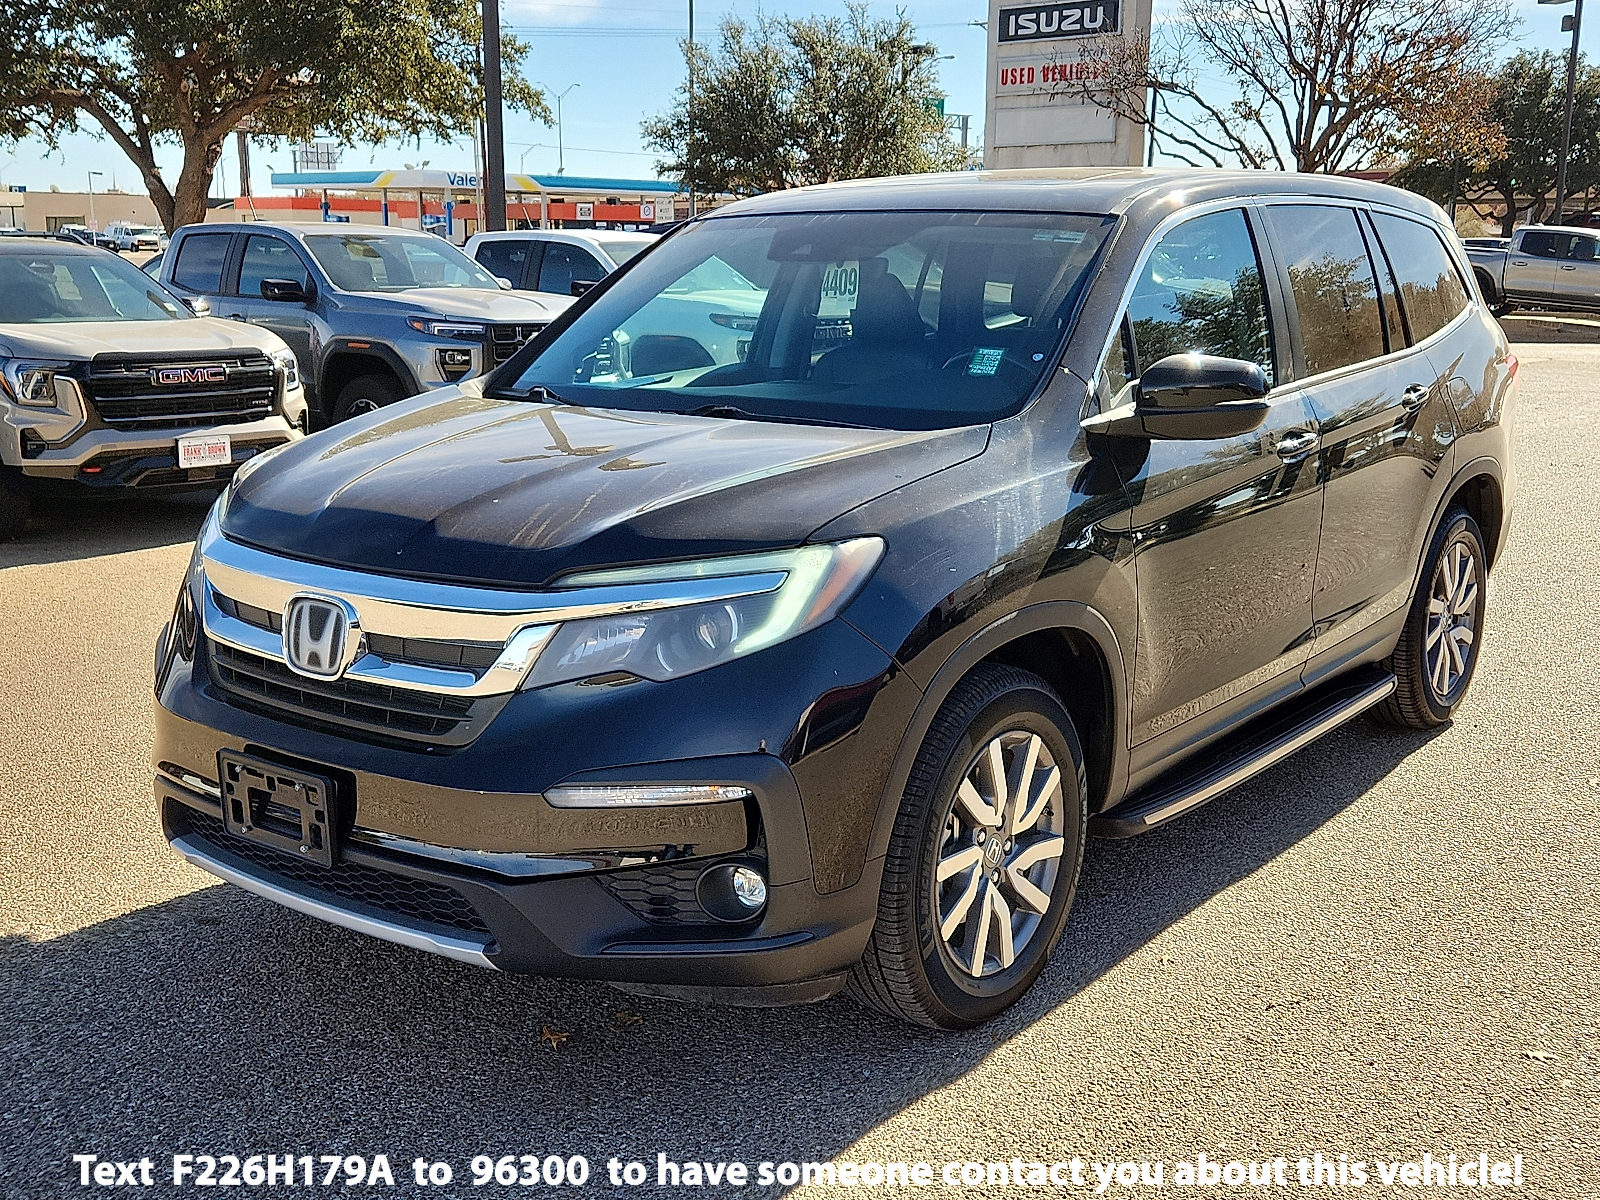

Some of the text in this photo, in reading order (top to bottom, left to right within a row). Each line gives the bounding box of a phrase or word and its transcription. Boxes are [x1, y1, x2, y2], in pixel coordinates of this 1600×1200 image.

[1008, 6, 1104, 36] ISUZU
[1001, 61, 1109, 86] USED VEHICLE
[446, 172, 483, 187] Vale
[823, 267, 857, 296] 4409
[159, 367, 225, 384] GMC
